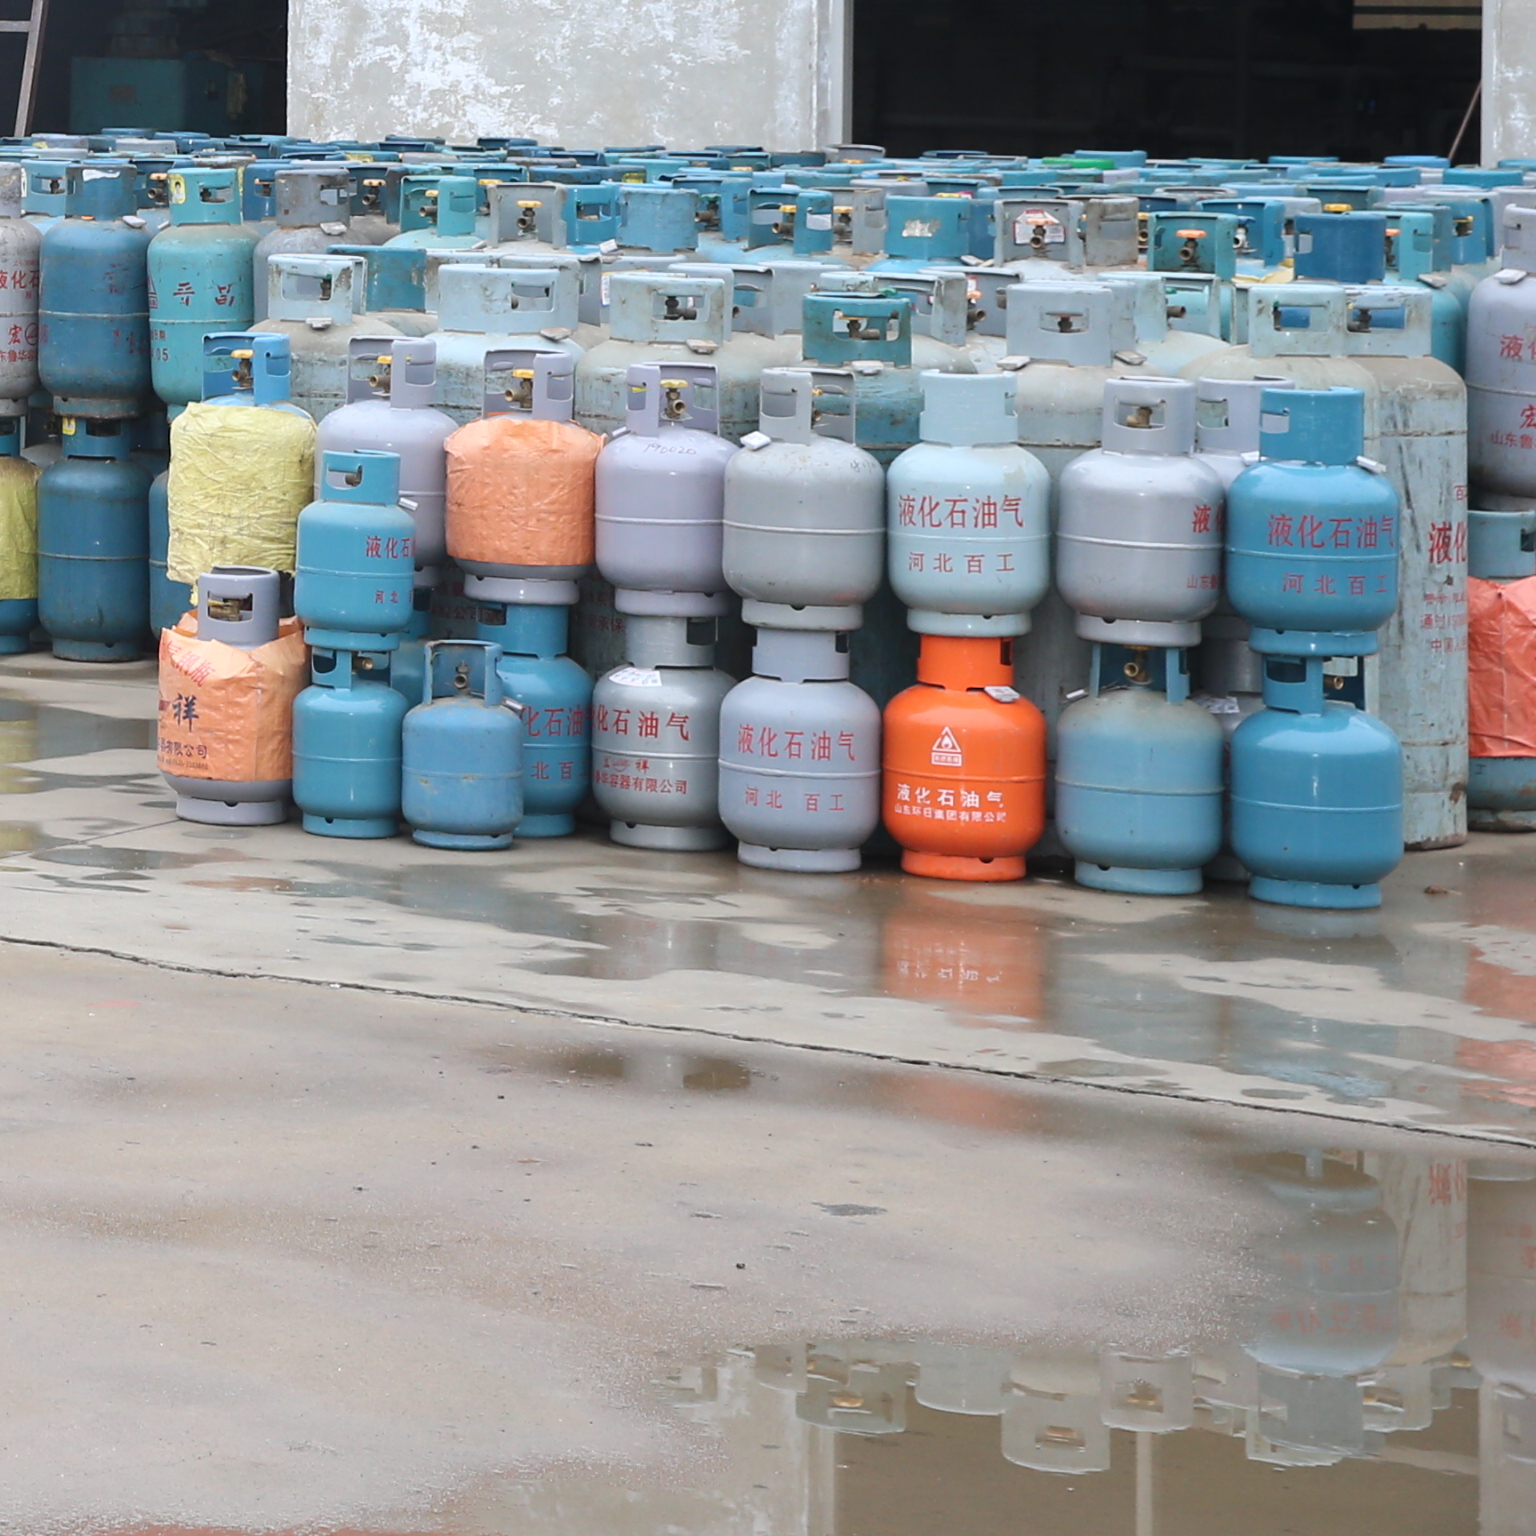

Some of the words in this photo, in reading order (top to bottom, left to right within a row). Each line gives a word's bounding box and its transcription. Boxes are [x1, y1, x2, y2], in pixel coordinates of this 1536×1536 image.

[898, 494, 1024, 529] 液化石油气
[1267, 514, 1396, 549] 液化石油气
[908, 551, 1015, 574] 河北百工
[1282, 573, 1389, 595] 河北百工
[172, 693, 199, 732] 祥
[520, 705, 592, 737] 化石油
[737, 723, 856, 761] 液化石油气
[897, 782, 1005, 808] 液化石油气
